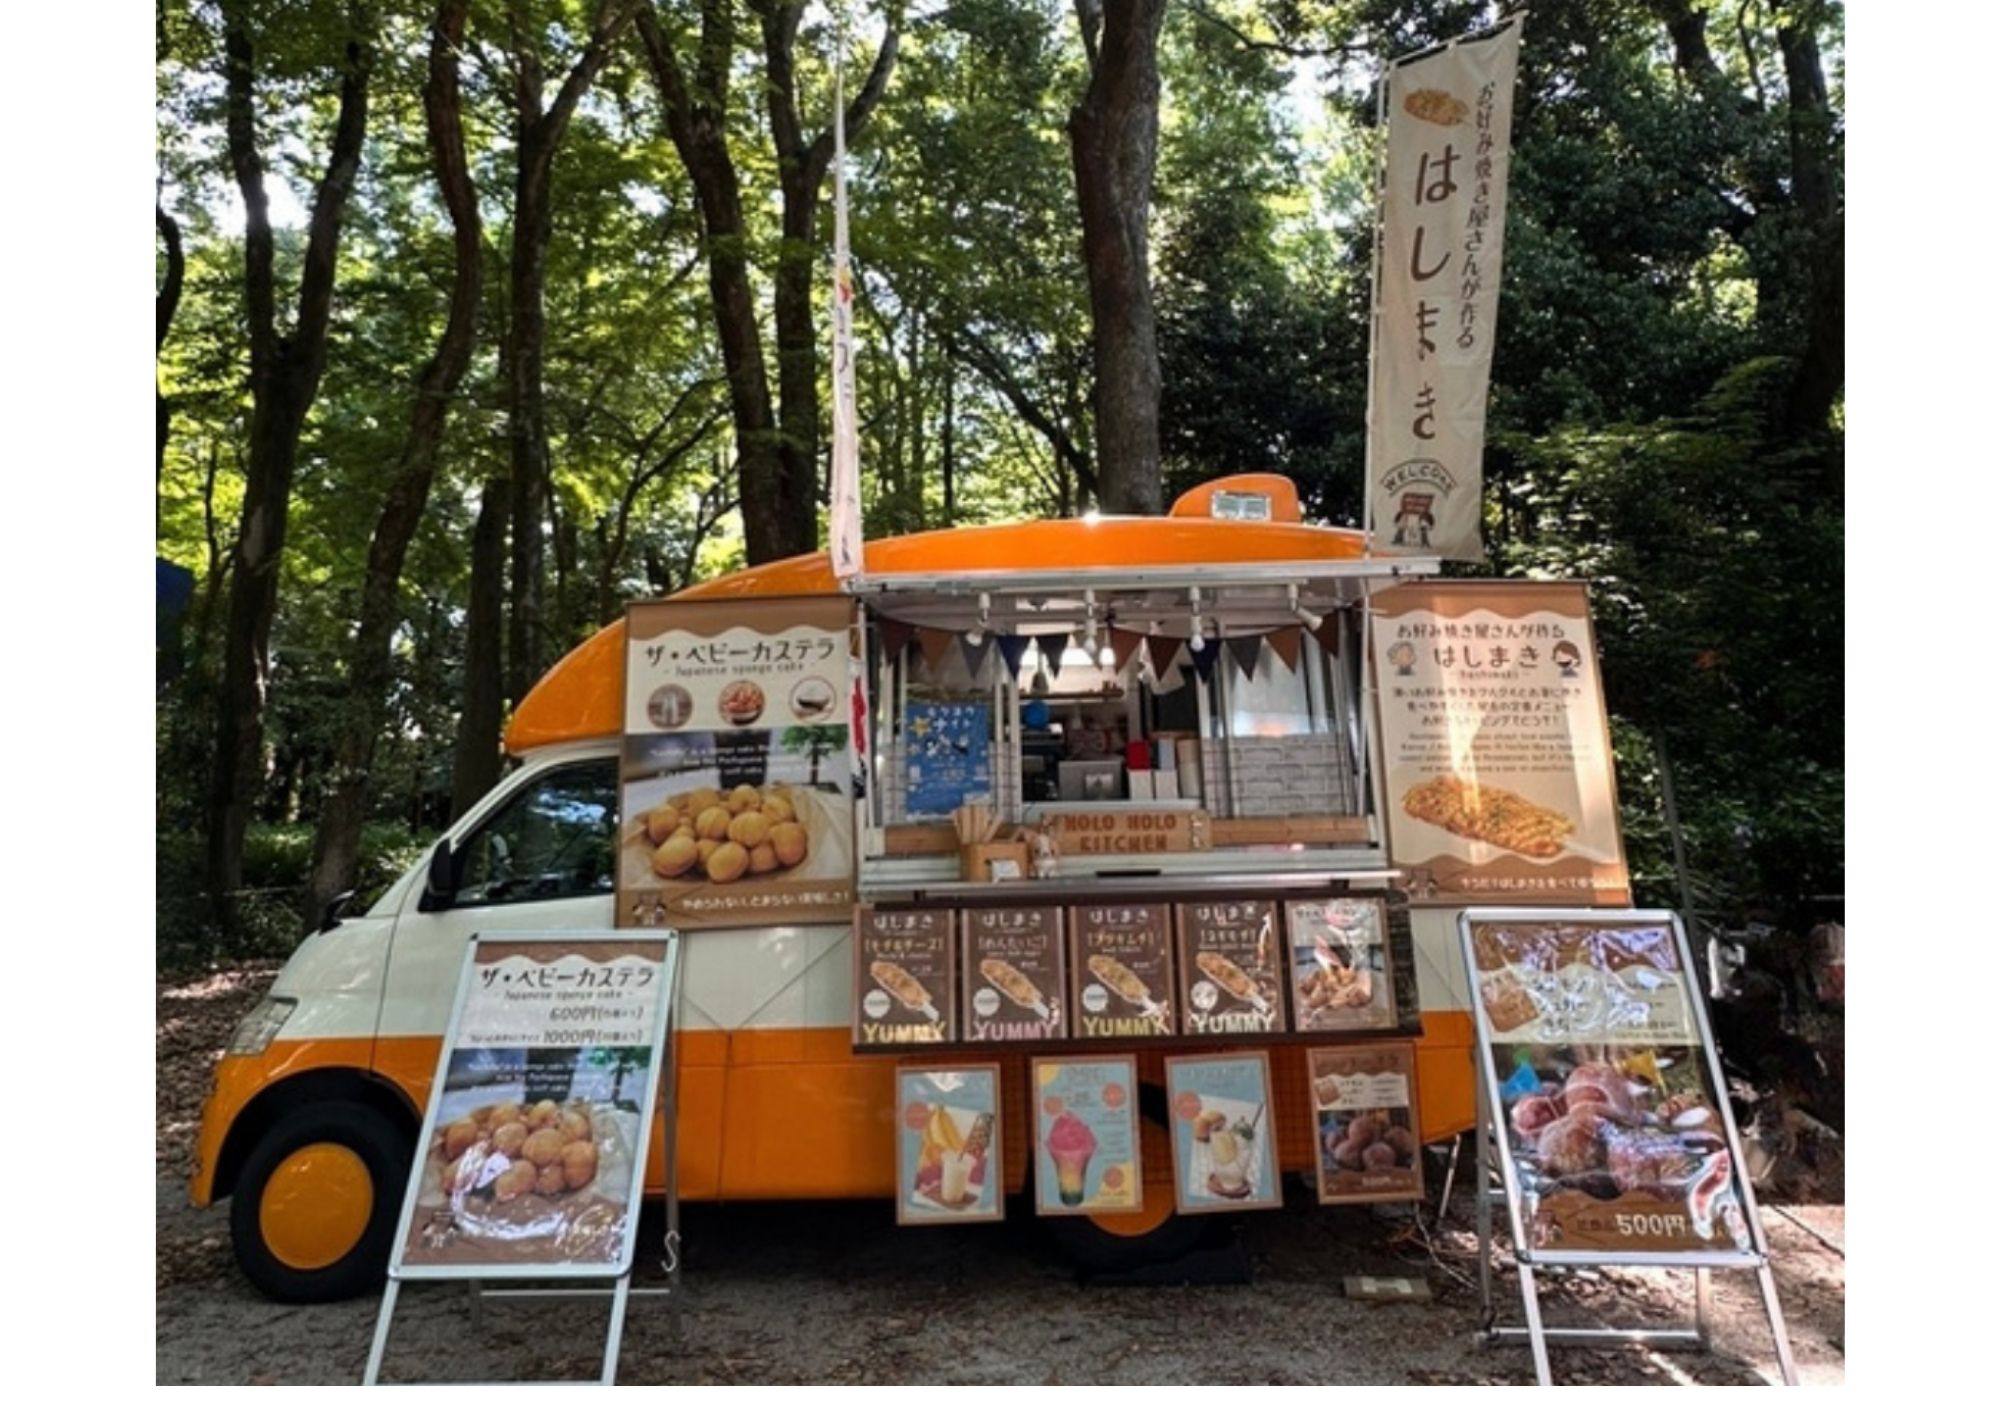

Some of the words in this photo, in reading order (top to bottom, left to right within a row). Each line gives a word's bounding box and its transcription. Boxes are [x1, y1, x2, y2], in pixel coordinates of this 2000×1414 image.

[1457, 80, 1495, 349] お好み焼き屋さんが作る
[1410, 143, 1461, 438] はしまき
[1434, 645, 1541, 668] はしまき
[1064, 814, 1115, 831] HOLO
[1127, 814, 1177, 830] HOLO
[1080, 834, 1167, 851] KITCHEN
[874, 914, 934, 929] はしまき
[982, 912, 1042, 926] はしまき
[1089, 909, 1149, 924] はしまき
[1196, 904, 1256, 921] はしまき
[482, 967, 654, 989] ザ・ベビーカステラ
[863, 1022, 947, 1043] YUMMY
[973, 1020, 1056, 1041] YUMMY
[1084, 1015, 1167, 1036] YUMMY
[1192, 1011, 1275, 1034] YUMMY
[1615, 1214, 1686, 1237] 500円
